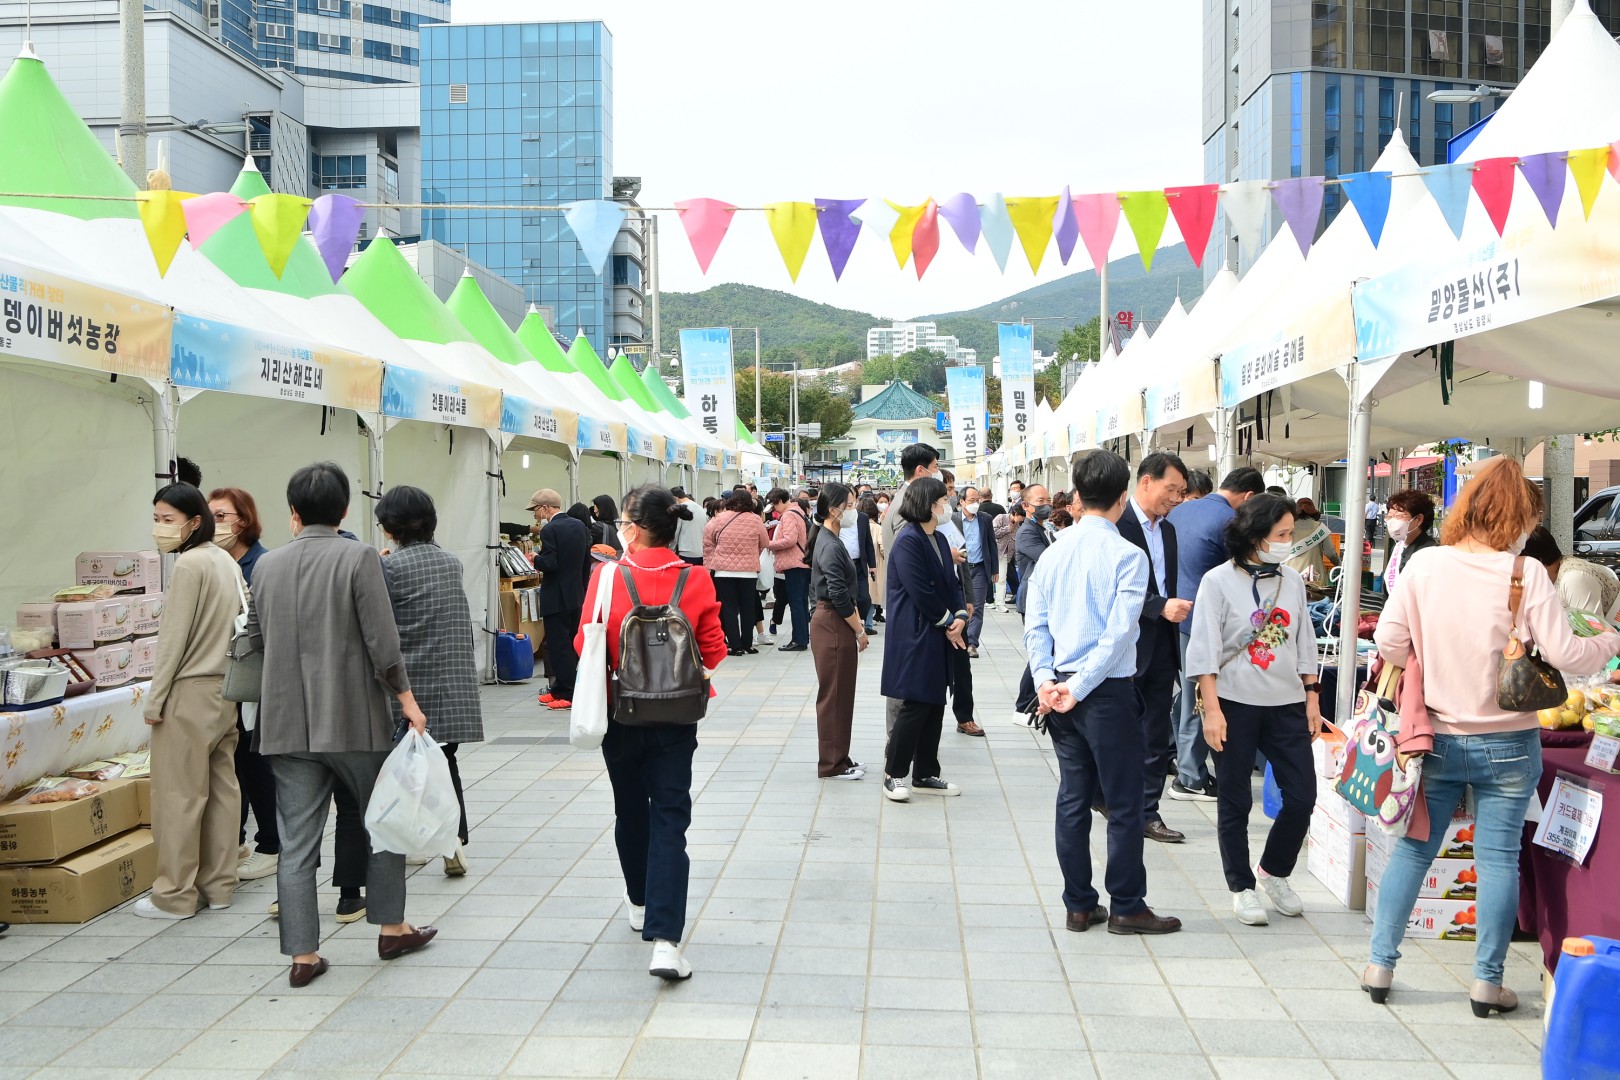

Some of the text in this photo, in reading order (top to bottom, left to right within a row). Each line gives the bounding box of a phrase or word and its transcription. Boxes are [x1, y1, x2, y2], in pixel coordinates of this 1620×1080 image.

[1427, 257, 1520, 324] 밀양물산(주)
[4, 298, 121, 354] 뎅이버섯농장
[1117, 310, 1134, 331] 약
[260, 357, 323, 390] 지리산해뜨네
[1241, 335, 1305, 386] 밀양 문화예술 공예품
[962, 416, 977, 464] 고성군
[1304, 529, 1326, 547] 밀양시
[11, 887, 48, 898] 하동농부
